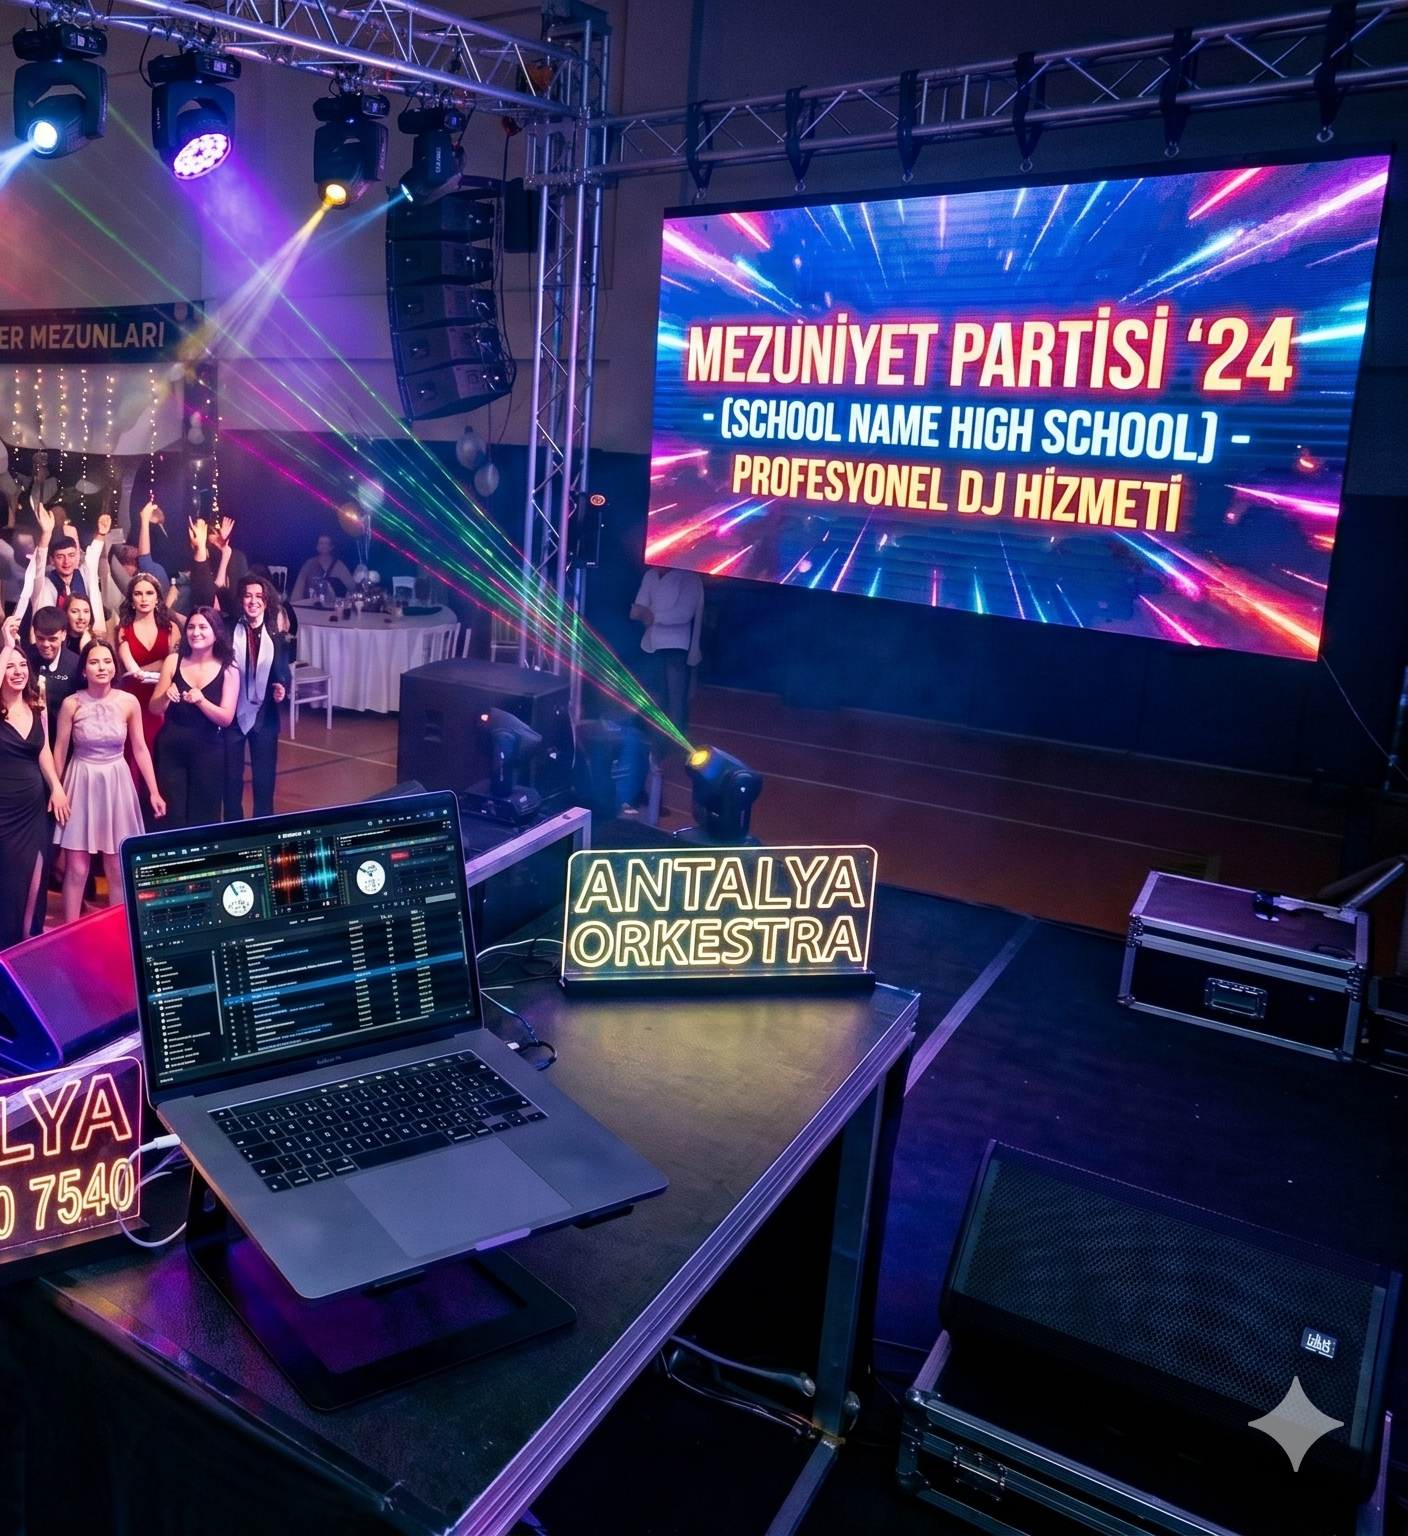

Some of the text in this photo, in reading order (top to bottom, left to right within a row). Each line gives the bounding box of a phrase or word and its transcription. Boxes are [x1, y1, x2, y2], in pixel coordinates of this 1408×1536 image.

[687, 313, 939, 386] MEZUNİYET
[950, 305, 1170, 390] PARTİSİ
[849, 403, 942, 447] NAME
[949, 407, 1034, 453] HIGH
[732, 454, 1182, 532] PROFESYONEL DJ HİZMETİ
[575, 855, 865, 913] ANTALYA
[570, 916, 862, 968] ORKESTRA
[29, 1157, 135, 1231] 7540
